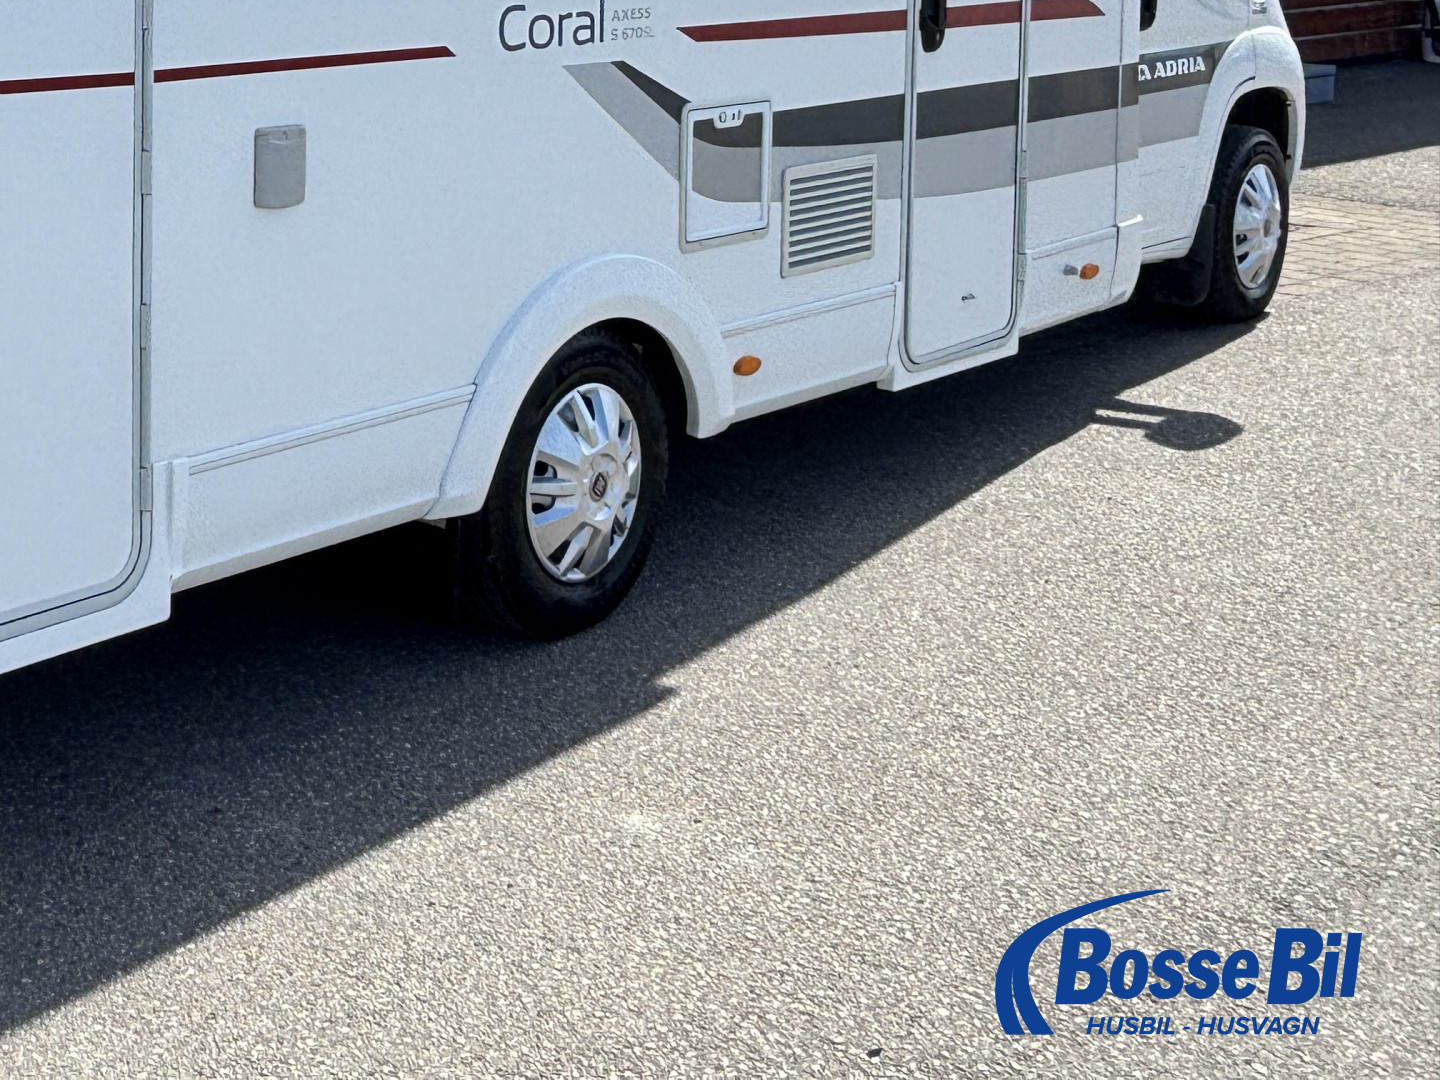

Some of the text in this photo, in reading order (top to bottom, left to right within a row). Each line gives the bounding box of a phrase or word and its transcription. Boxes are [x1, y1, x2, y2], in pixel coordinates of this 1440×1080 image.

[499, 0, 651, 52] Coral AXESS
[611, 28, 618, 41] S
[1154, 56, 1206, 79] ADRIA
